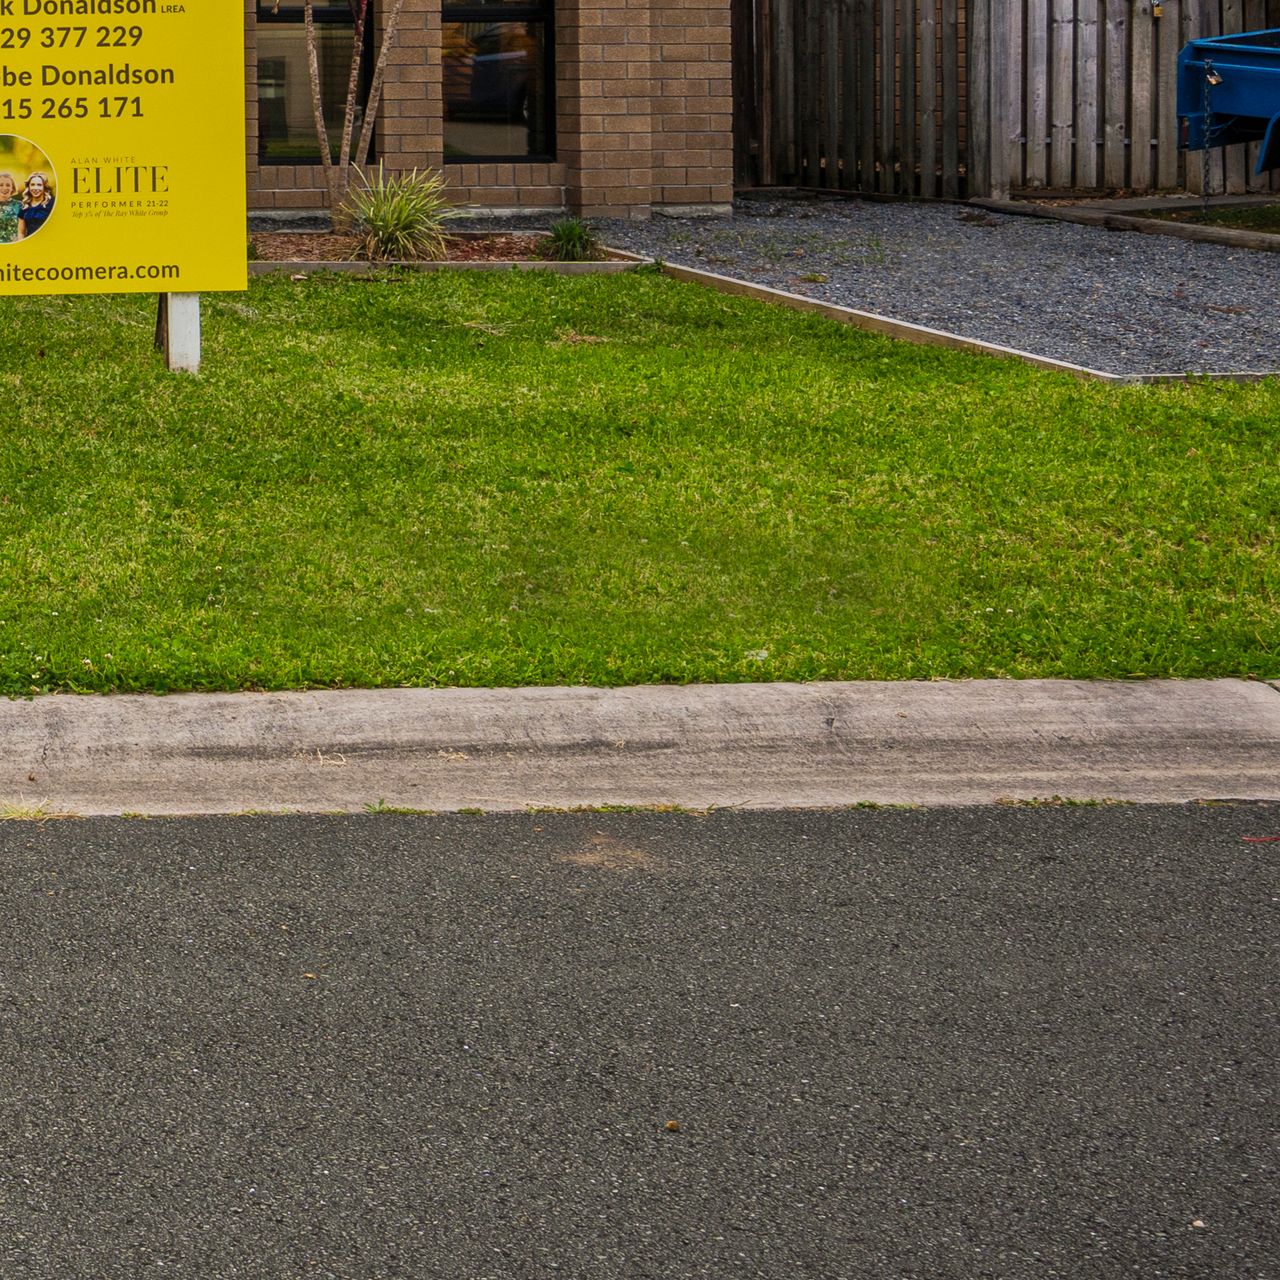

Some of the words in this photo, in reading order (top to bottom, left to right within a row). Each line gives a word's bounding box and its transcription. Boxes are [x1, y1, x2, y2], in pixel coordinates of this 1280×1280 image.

[161, 5, 186, 14] LREA
[40, 26, 87, 48] 377
[96, 25, 143, 47] 229
[41, 63, 174, 86] Donaldson
[41, 97, 88, 119] 265
[98, 96, 144, 118] 171
[103, 156, 136, 164] WHITE
[72, 166, 168, 193] ELITE
